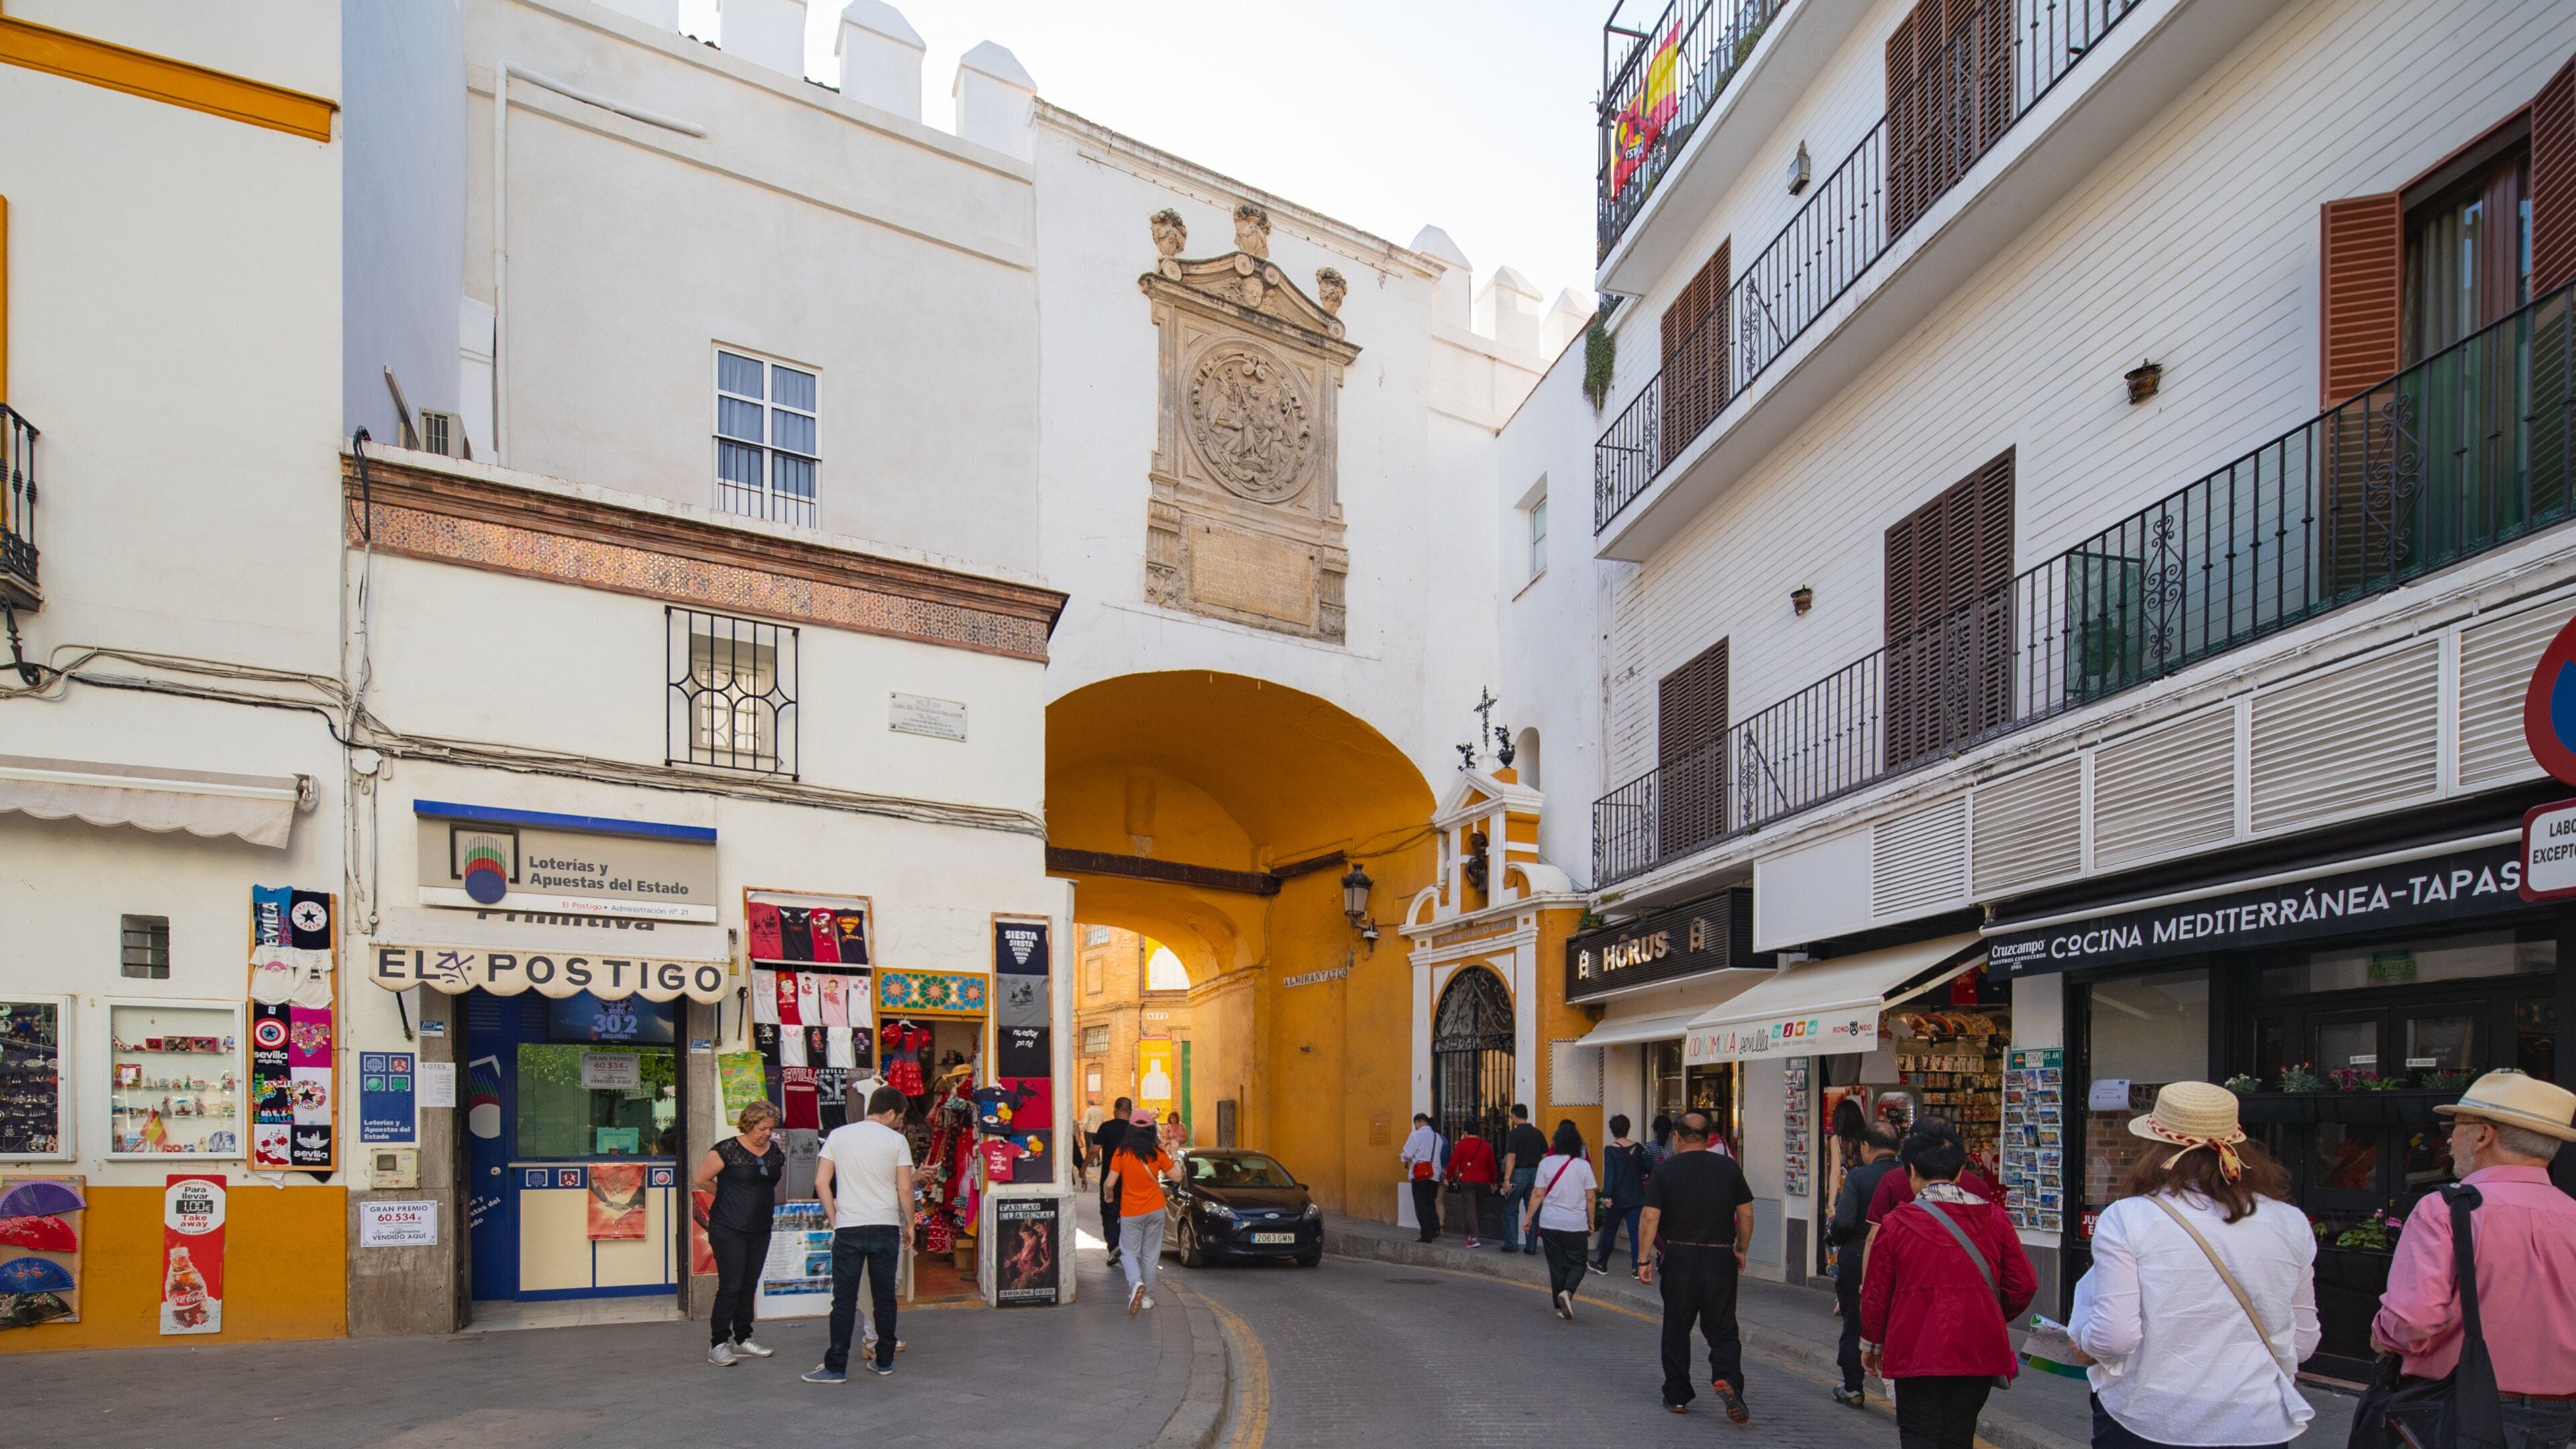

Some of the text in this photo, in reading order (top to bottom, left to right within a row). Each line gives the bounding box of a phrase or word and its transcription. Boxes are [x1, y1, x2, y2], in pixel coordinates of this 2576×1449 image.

[2532, 845, 2576, 865] EXCEPT
[529, 856, 608, 876] Loterías y
[530, 873, 689, 896] Apuestas del Estado
[572, 902, 602, 911] Postigo
[611, 905, 665, 914] Administración
[1005, 930, 1038, 941] SIESTA
[2051, 924, 2143, 959] COCINA
[1009, 939, 1034, 948] SIESTA
[1992, 939, 2045, 958] Cruzcampo
[1990, 958, 2014, 966] MAESTROS
[2015, 953, 2046, 962] CERVECEROS
[378, 949, 441, 981] EL
[488, 953, 721, 993] POSTIGO
[1739, 1029, 1769, 1055] sevilla
[254, 1050, 288, 1059] sevilla
[294, 1150, 328, 1159] sevilla
[177, 1181, 199, 1189] BEBIDAS
[378, 1213, 415, 1222] 60.534
[1015, 1211, 1055, 1219] ARENAL
[1257, 1234, 1276, 1242] 2063
